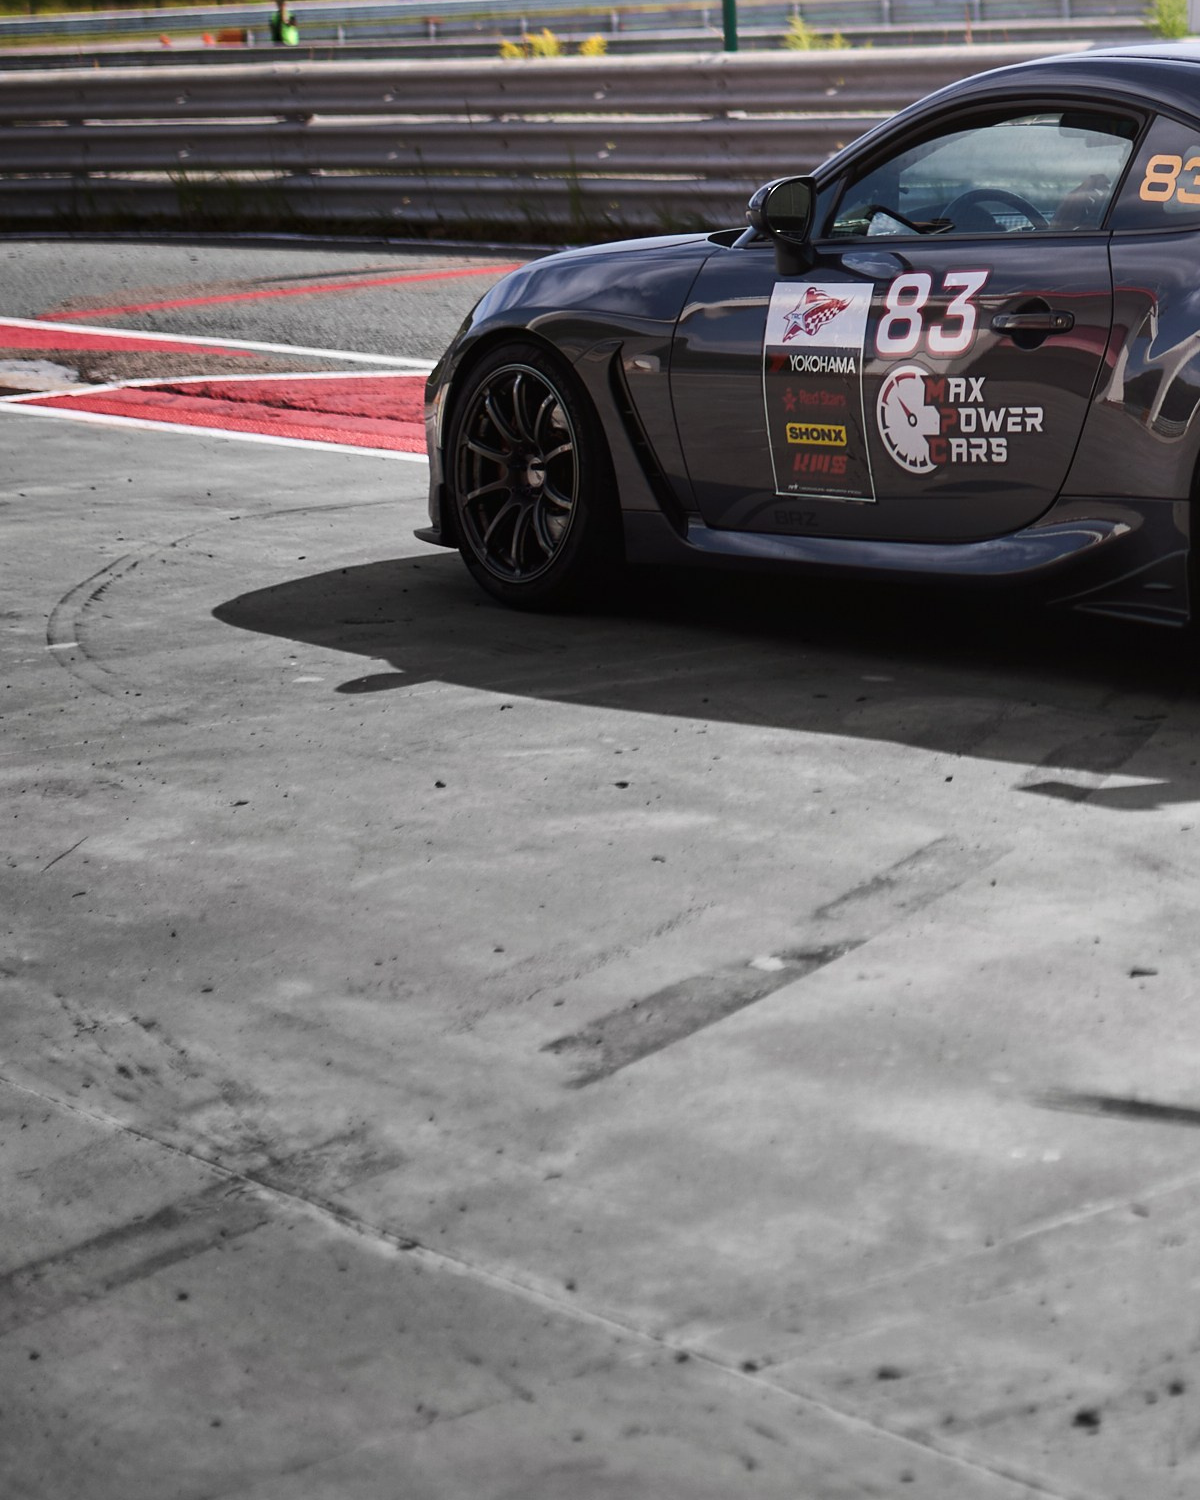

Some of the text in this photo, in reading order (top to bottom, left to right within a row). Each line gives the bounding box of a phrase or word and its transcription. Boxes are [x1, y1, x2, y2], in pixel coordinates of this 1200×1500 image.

[874, 269, 991, 357] 83
[789, 354, 857, 374] YOKOHAMA
[799, 390, 819, 405] Red
[924, 376, 986, 403] MAX
[939, 407, 1044, 434] POWER
[789, 426, 844, 443] SHONX
[928, 437, 1008, 465] CARS
[773, 510, 819, 527] BRZ
